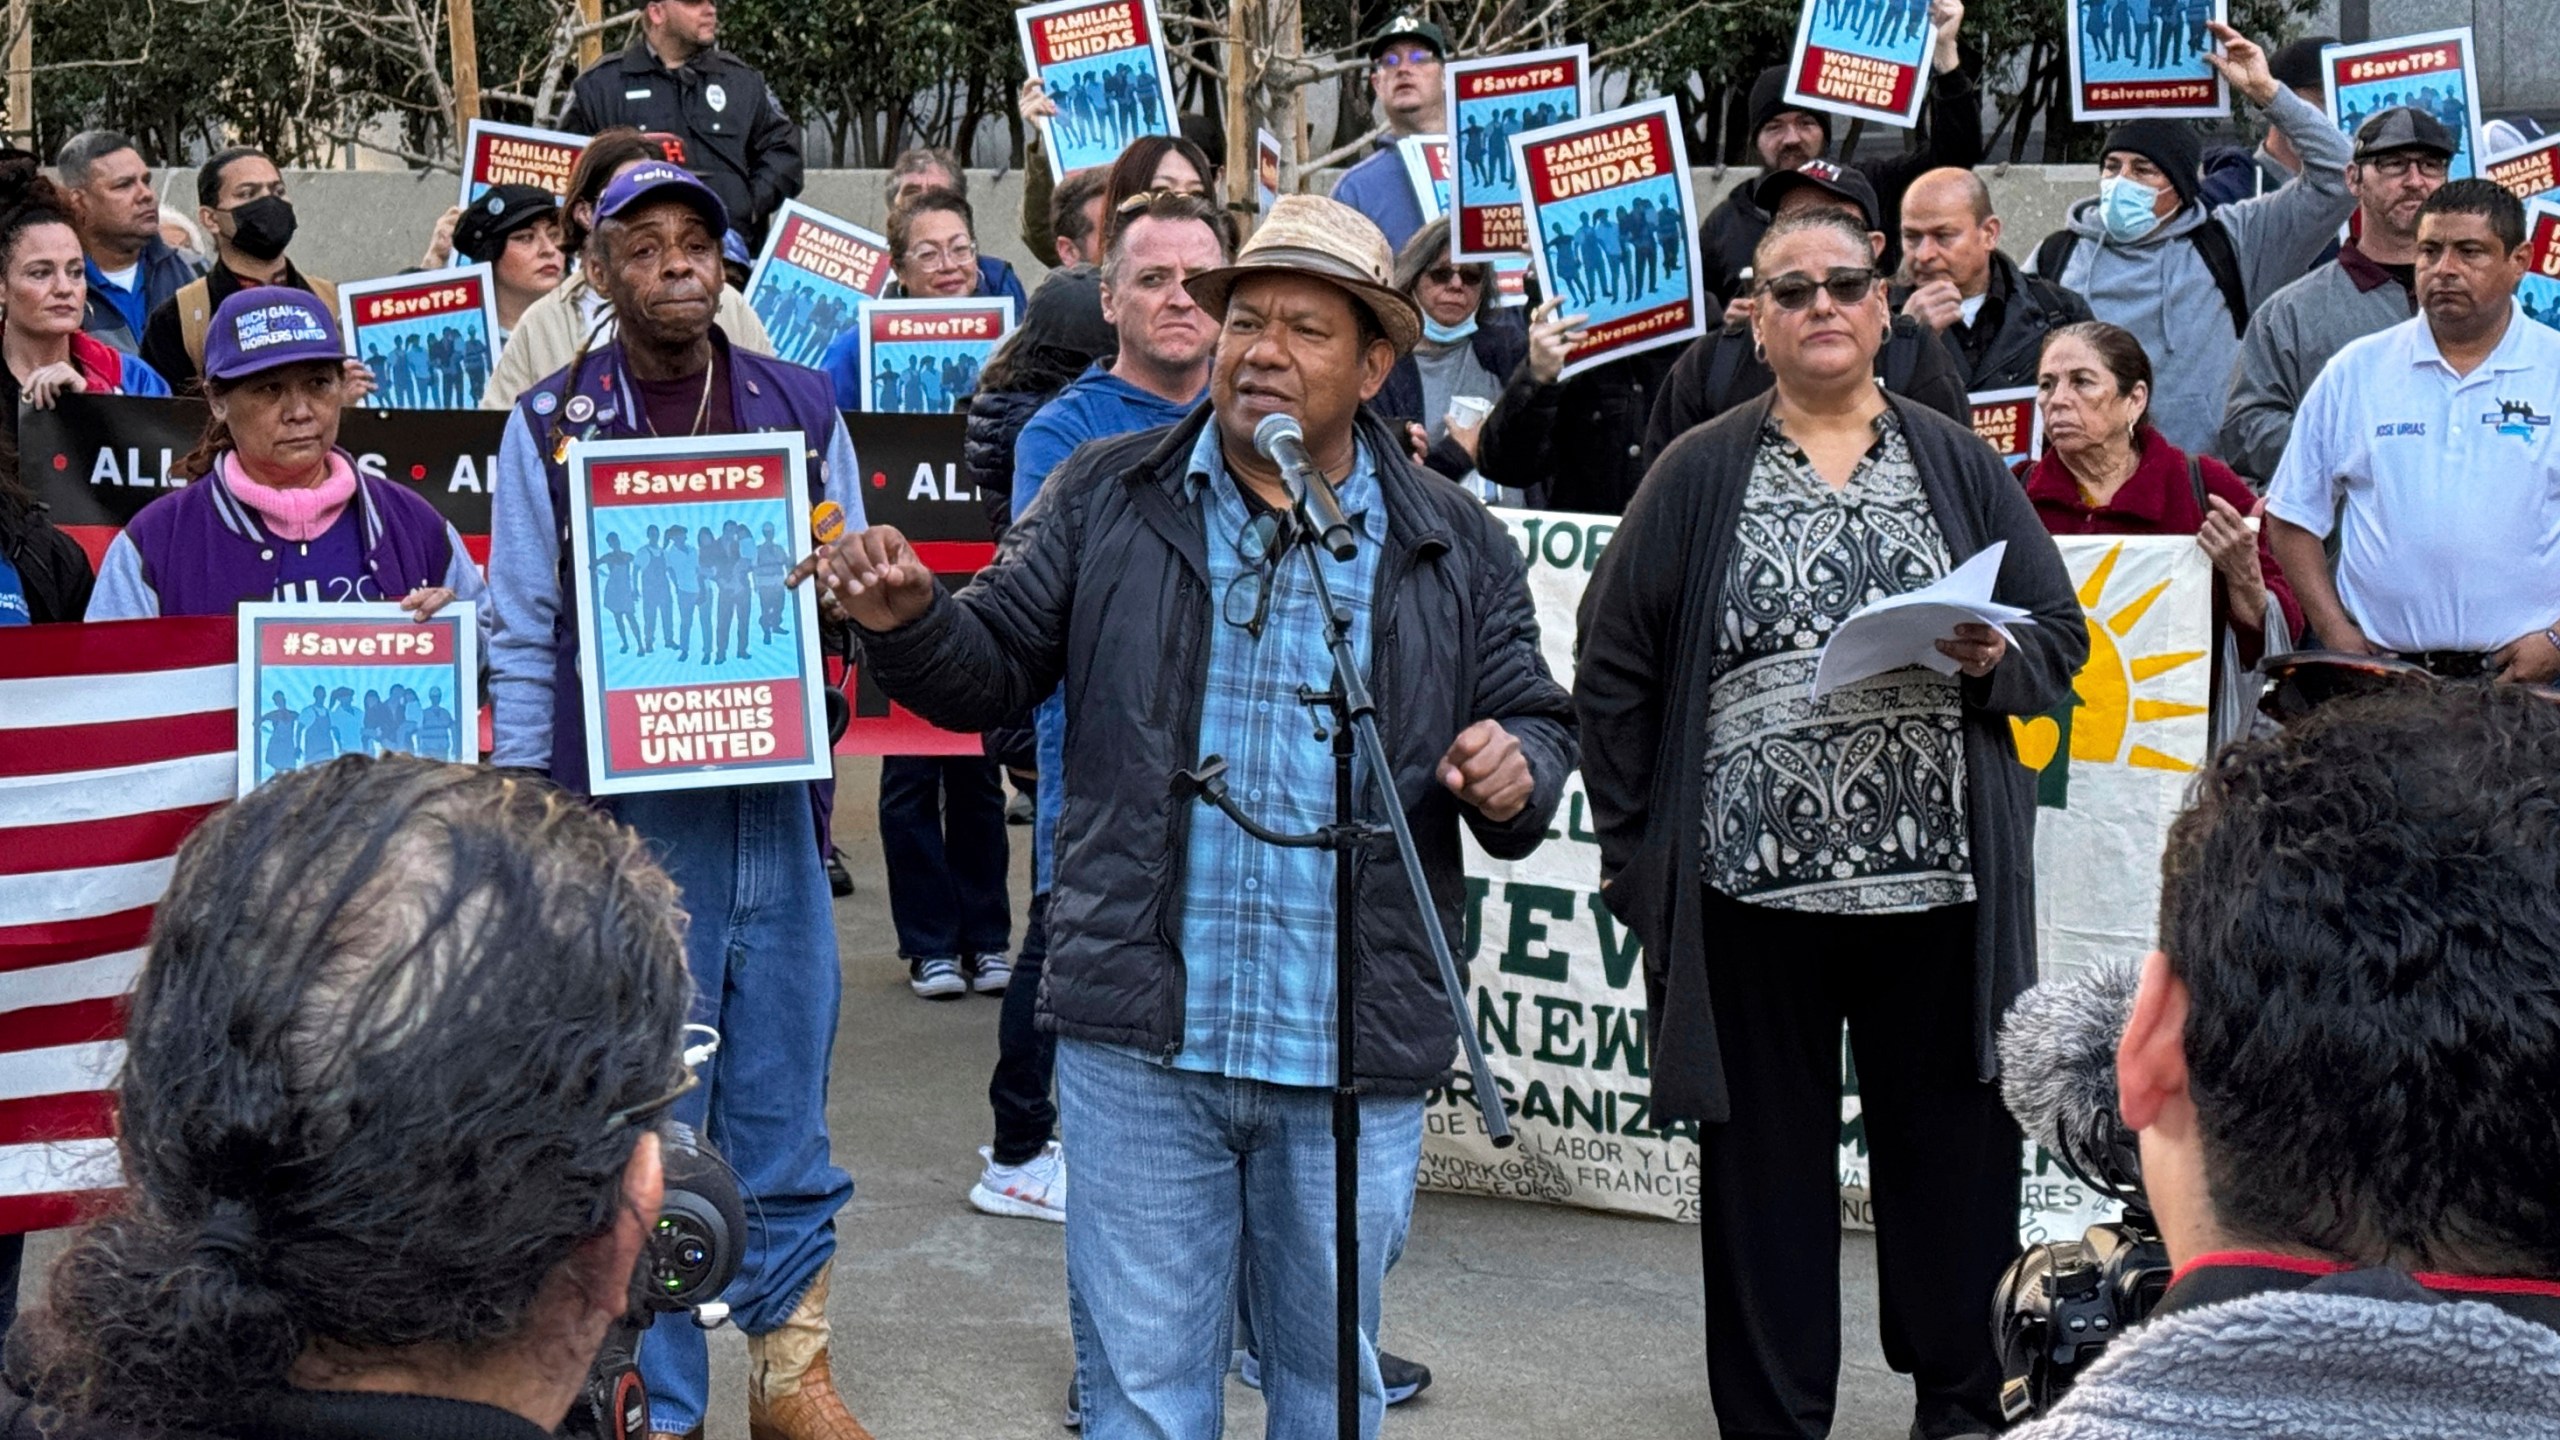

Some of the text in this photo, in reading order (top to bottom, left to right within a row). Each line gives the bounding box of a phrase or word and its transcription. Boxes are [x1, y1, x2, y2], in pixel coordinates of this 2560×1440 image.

[1044, 3, 1131, 34] FAMILIAS
[1047, 18, 1133, 44] TRABAJADORAS
[1050, 29, 1136, 61] UNIDAS
[1821, 63, 1897, 91] FAMILIES
[1824, 51, 1900, 77] WORKING
[2350, 50, 2447, 78] #SaveTPS
[1472, 67, 1564, 94] #SaveTPS
[1817, 77, 1893, 106] UNITED
[2091, 85, 2209, 100] #SalvemosTPS
[490, 139, 572, 165] FAMILIAS
[1544, 123, 1650, 165] FAMILIAS
[489, 154, 570, 176] TRABAJADORAS
[1548, 141, 1653, 178] TRABAJADORAS
[487, 165, 568, 194] UNIDAS
[1551, 155, 1657, 198] UNIDAS
[797, 222, 881, 265] FAMILIAS
[788, 245, 870, 290] UNIDAS
[370, 287, 468, 319] #SaveTPS
[240, 328, 293, 352] WORKERS
[888, 317, 988, 336] #SaveTPS
[614, 465, 764, 494] #SaveTPS
[907, 462, 982, 501] AL
[283, 632, 434, 656] #SaveTPS
[635, 685, 772, 713] WORKING
[640, 707, 773, 737] FAMILIES
[641, 732, 776, 764] UNITED
[1478, 985, 1649, 1078] NEW
[1537, 1134, 1623, 1164] LABOR
